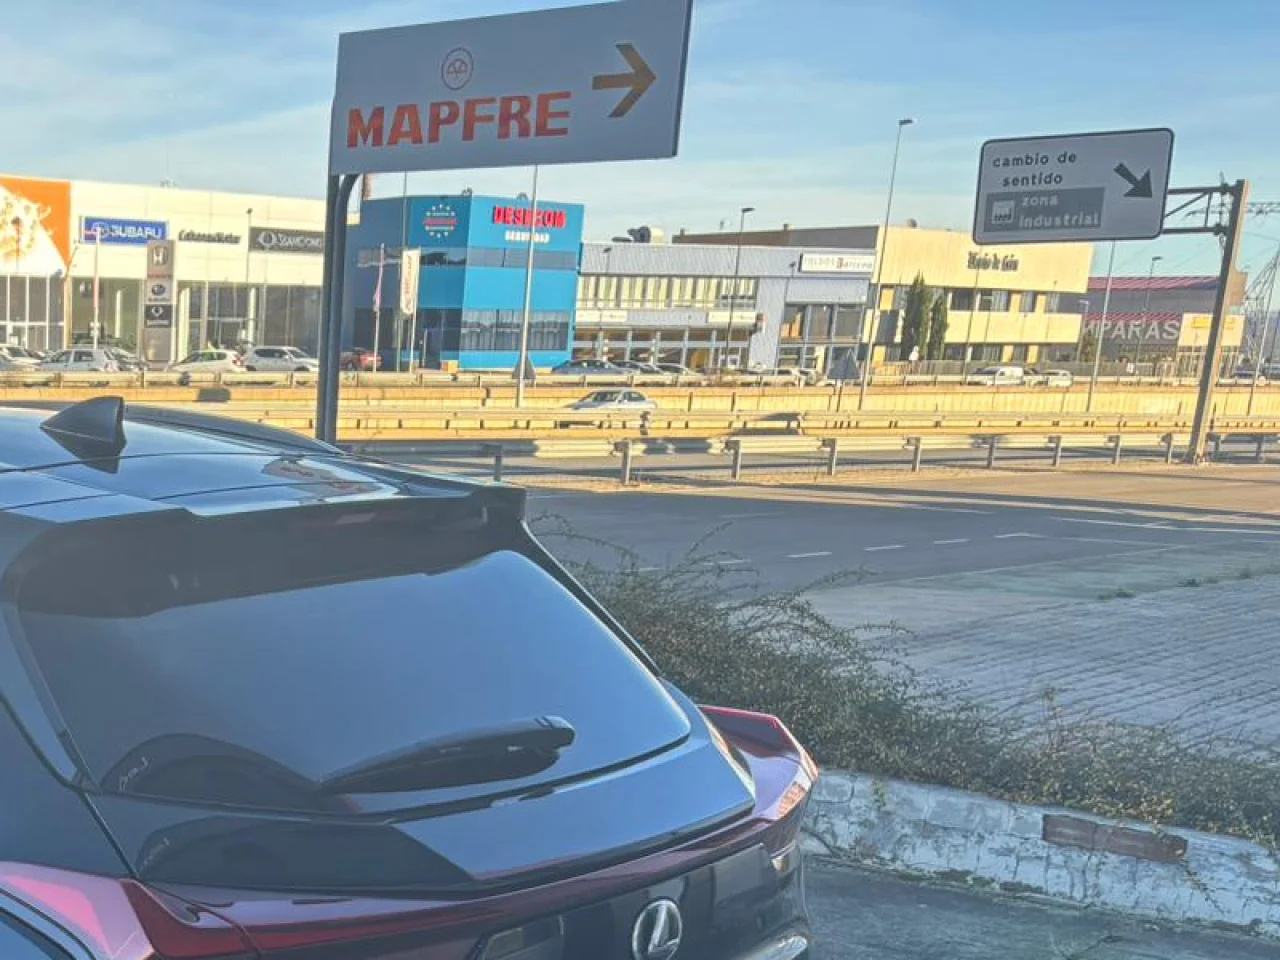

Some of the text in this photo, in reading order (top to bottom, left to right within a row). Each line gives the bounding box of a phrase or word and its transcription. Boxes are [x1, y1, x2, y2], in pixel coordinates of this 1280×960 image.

[346, 91, 571, 148] MAPFRE
[992, 151, 1077, 168] cambio de
[1002, 172, 1063, 187] sentido
[1021, 195, 1058, 207] zona
[1020, 212, 1099, 228] industrial
[110, 224, 163, 240] SUBARU
